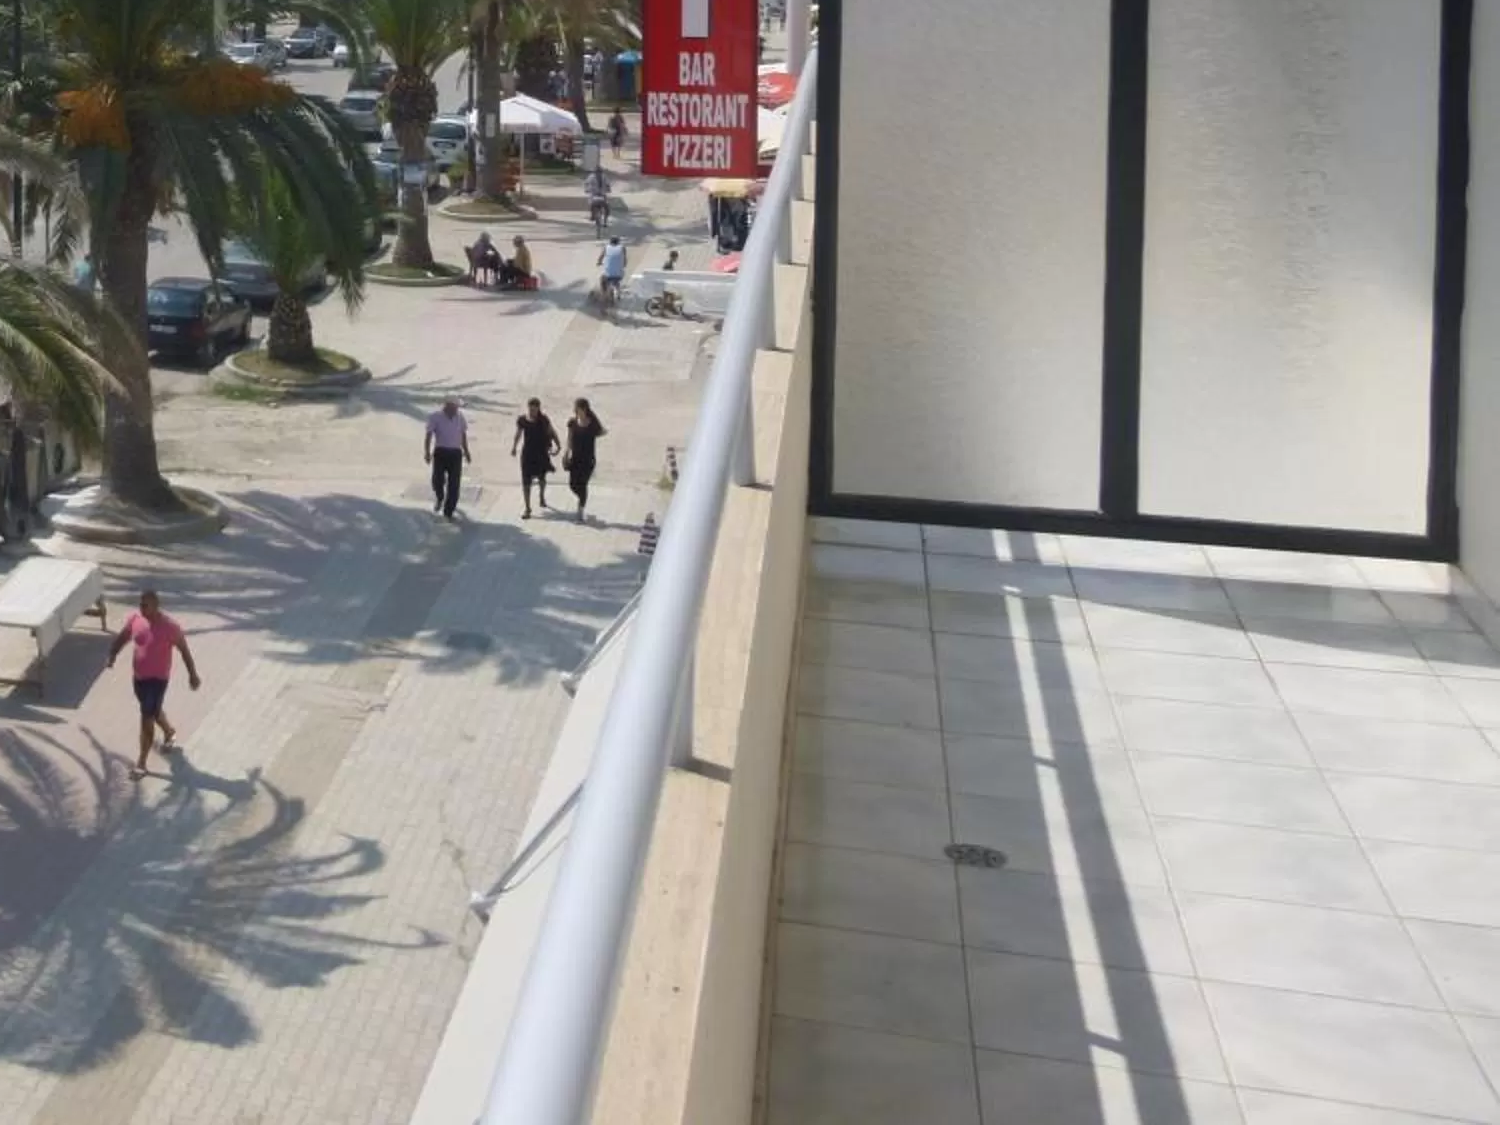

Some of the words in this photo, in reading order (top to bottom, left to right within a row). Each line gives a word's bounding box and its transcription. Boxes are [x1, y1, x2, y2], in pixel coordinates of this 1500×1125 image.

[678, 51, 716, 86] BAR
[647, 91, 749, 128] RESTORANT
[663, 133, 732, 170] PIZZERI
